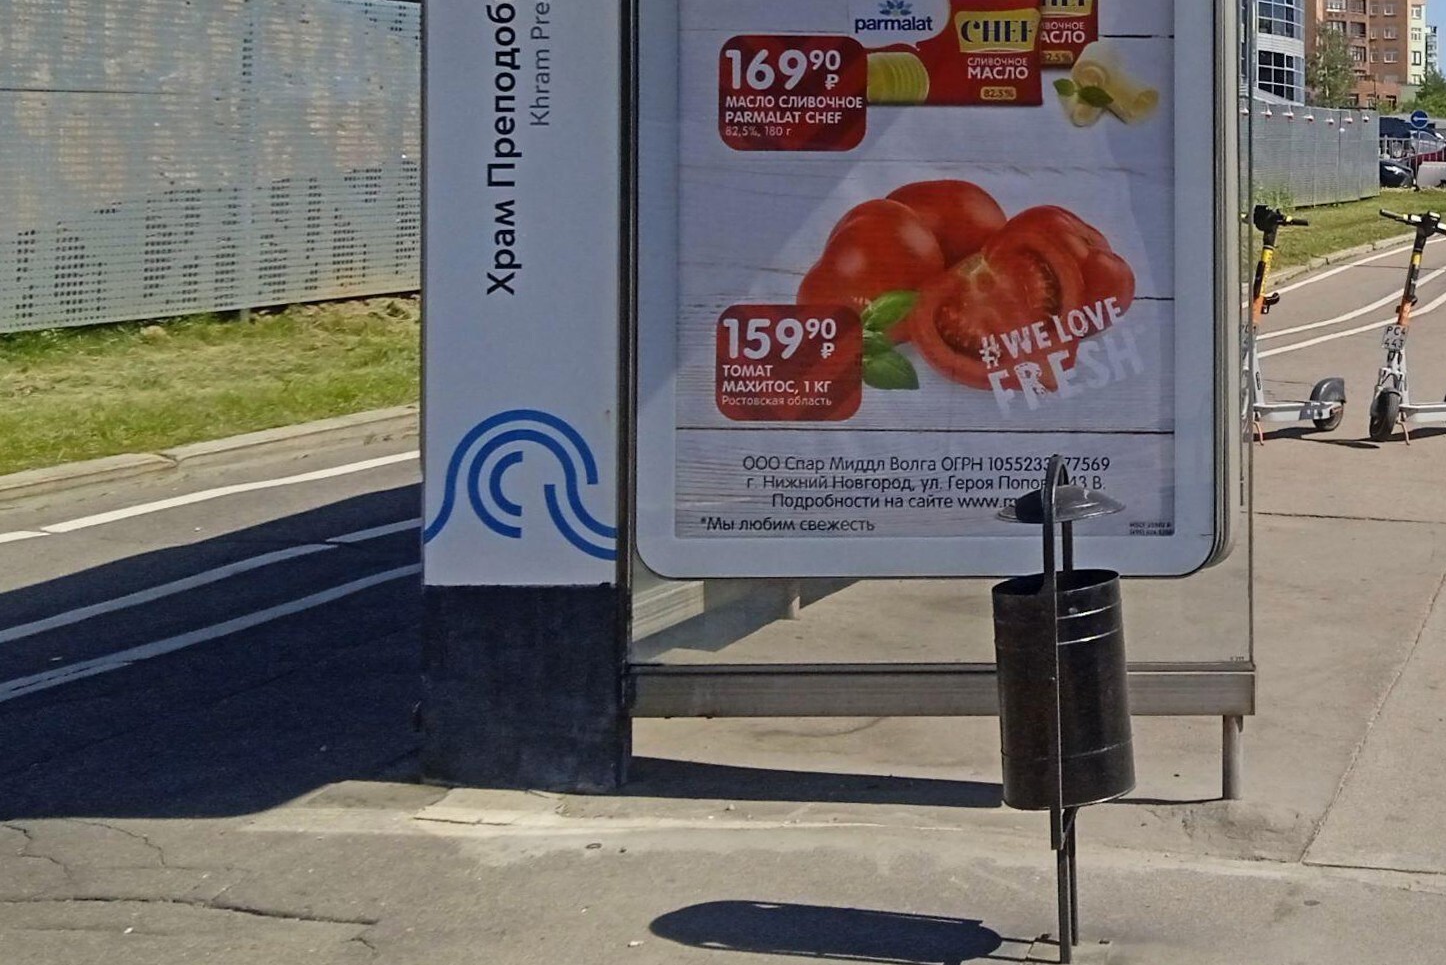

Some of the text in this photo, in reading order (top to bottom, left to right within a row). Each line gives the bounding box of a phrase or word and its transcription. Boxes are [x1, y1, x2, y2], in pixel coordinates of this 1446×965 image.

[854, 16, 934, 34] parmalat
[960, 20, 1035, 43] CHEF
[1041, 30, 1086, 43] АСЛО
[725, 48, 841, 90] 169 90
[967, 57, 1028, 67] СЛИВОЧНОЕ
[967, 66, 1029, 80] МАСЛО
[530, 49, 550, 126] Khram
[725, 96, 863, 109] МАСЛО СЛИВОЧНОЕ
[725, 111, 842, 124] PARMALAT CHEF
[765, 126, 783, 136] 180
[486, 199, 522, 296] Храм
[723, 318, 837, 360] 159 90
[979, 296, 1122, 369] #WE LOVE
[722, 364, 773, 377] ТОМАТ
[987, 328, 1144, 418] FRESH
[722, 380, 832, 395] МАХИТОС, 1 КГ
[722, 395, 832, 406] Ростовская область
[742, 456, 1110, 474] ООО Спар Миддл Волга ОГРН 105523377569
[763, 475, 827, 489] Нижний
[833, 476, 915, 492] Новгород,
[921, 478, 945, 492] ул.
[949, 476, 994, 492] Героя
[772, 493, 880, 510] Подробности
[885, 497, 903, 507] на
[908, 494, 953, 508] сайте
[739, 517, 795, 531] любим
[799, 519, 875, 531] свежесть
